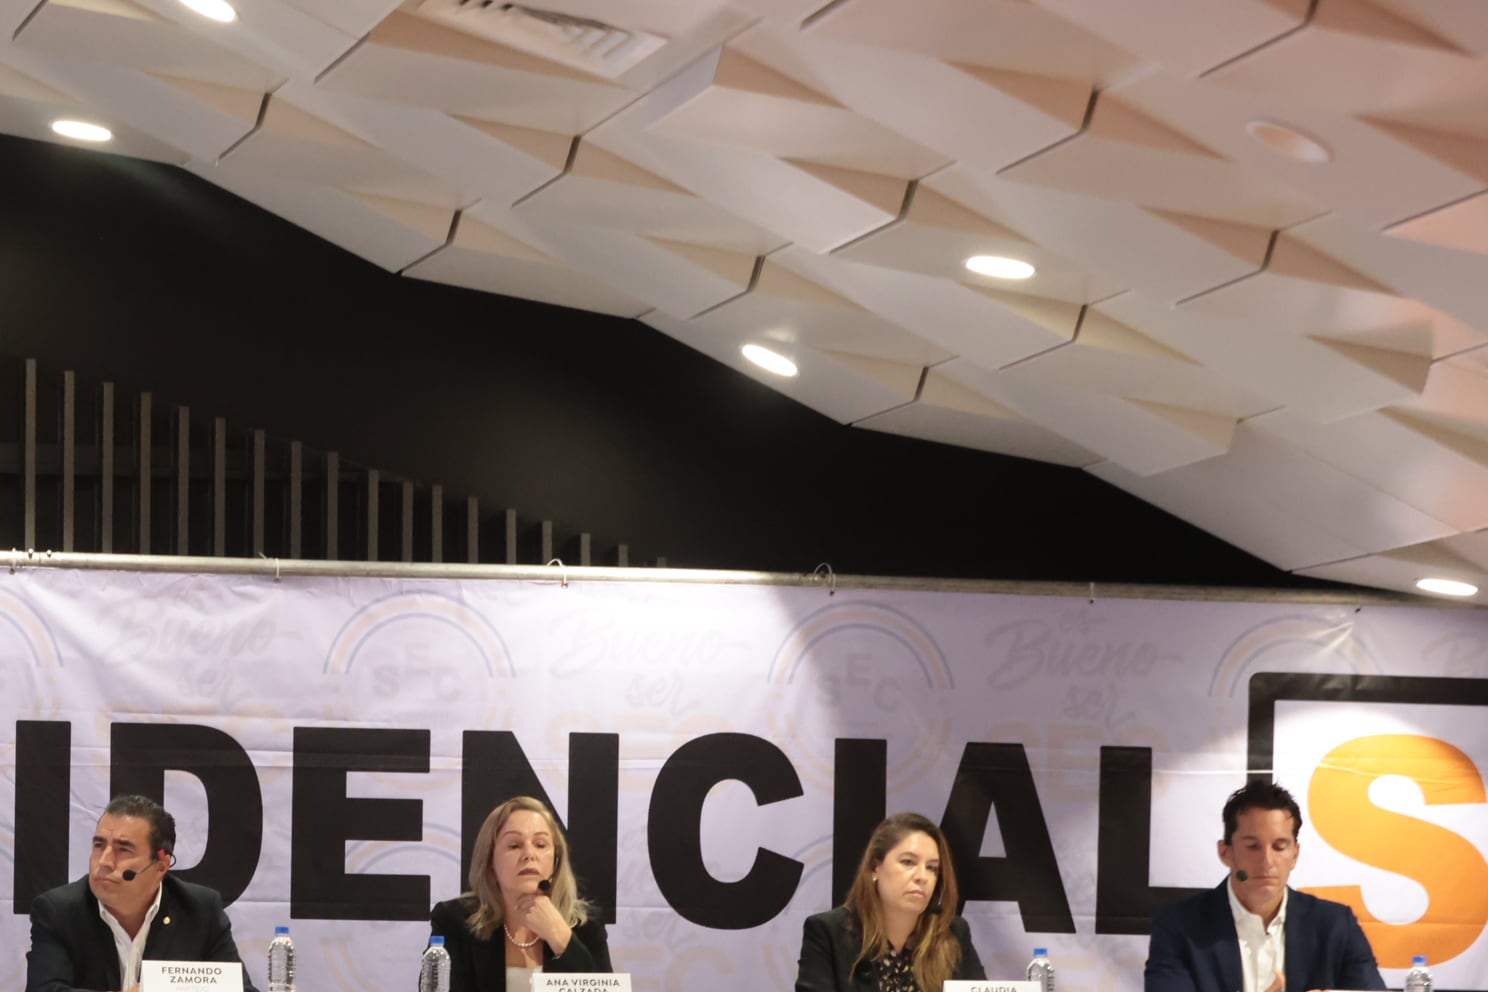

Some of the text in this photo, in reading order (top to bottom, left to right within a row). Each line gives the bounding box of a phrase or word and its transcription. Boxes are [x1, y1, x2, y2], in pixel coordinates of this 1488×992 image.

[161, 966, 223, 976] FERNANDO
[169, 975, 218, 985] ZAMORA
[546, 979, 621, 988] ANA VIRGINIA
